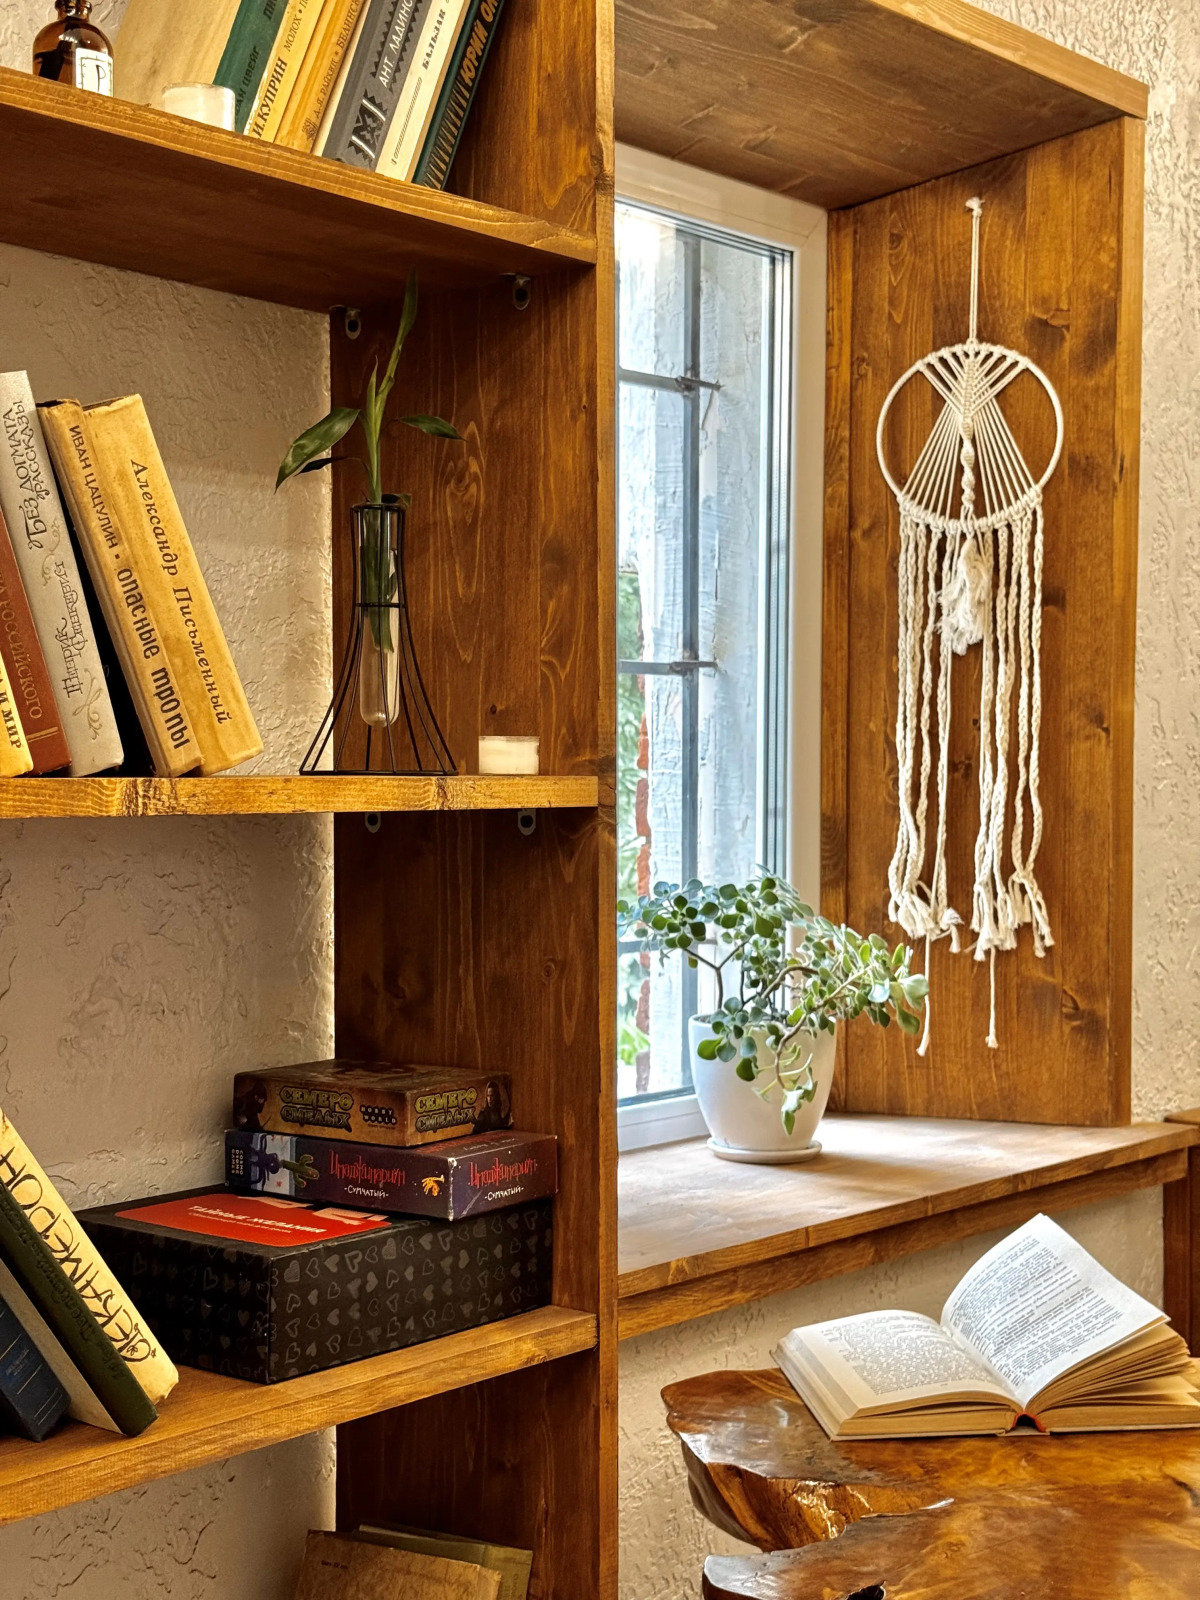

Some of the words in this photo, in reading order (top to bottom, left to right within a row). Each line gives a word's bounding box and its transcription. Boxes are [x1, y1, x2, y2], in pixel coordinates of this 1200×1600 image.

[284, 14, 302, 53] МОЛОХ
[422, 8, 446, 71] БАЛЬЗАК
[460, 18, 488, 87] ЮРИЙ
[242, 45, 260, 88] ЦВЕЙГ
[2, 408, 35, 493] ДОГМАТА
[13, 400, 51, 501] РАССКАЗЫ
[18, 497, 48, 550] БЕЗ
[68, 424, 92, 470] ИВАН
[83, 470, 119, 550] ЦАЦУЛИН
[116, 567, 160, 660] опасные
[150, 666, 191, 750] тропы
[130, 458, 178, 577] Александр
[172, 586, 232, 725] Письменный
[55, 617, 84, 699] ГЕНРИК
[2, 708, 22, 750] МИР
[280, 1086, 353, 1111] СЕМЕРО
[281, 1106, 352, 1133] СМЕЛЫХ
[361, 1106, 393, 1116] HOBBY
[364, 1115, 397, 1124] WORLD
[414, 1087, 478, 1114] СЕМЕРО
[415, 1107, 476, 1133] СМЕЛЫХ
